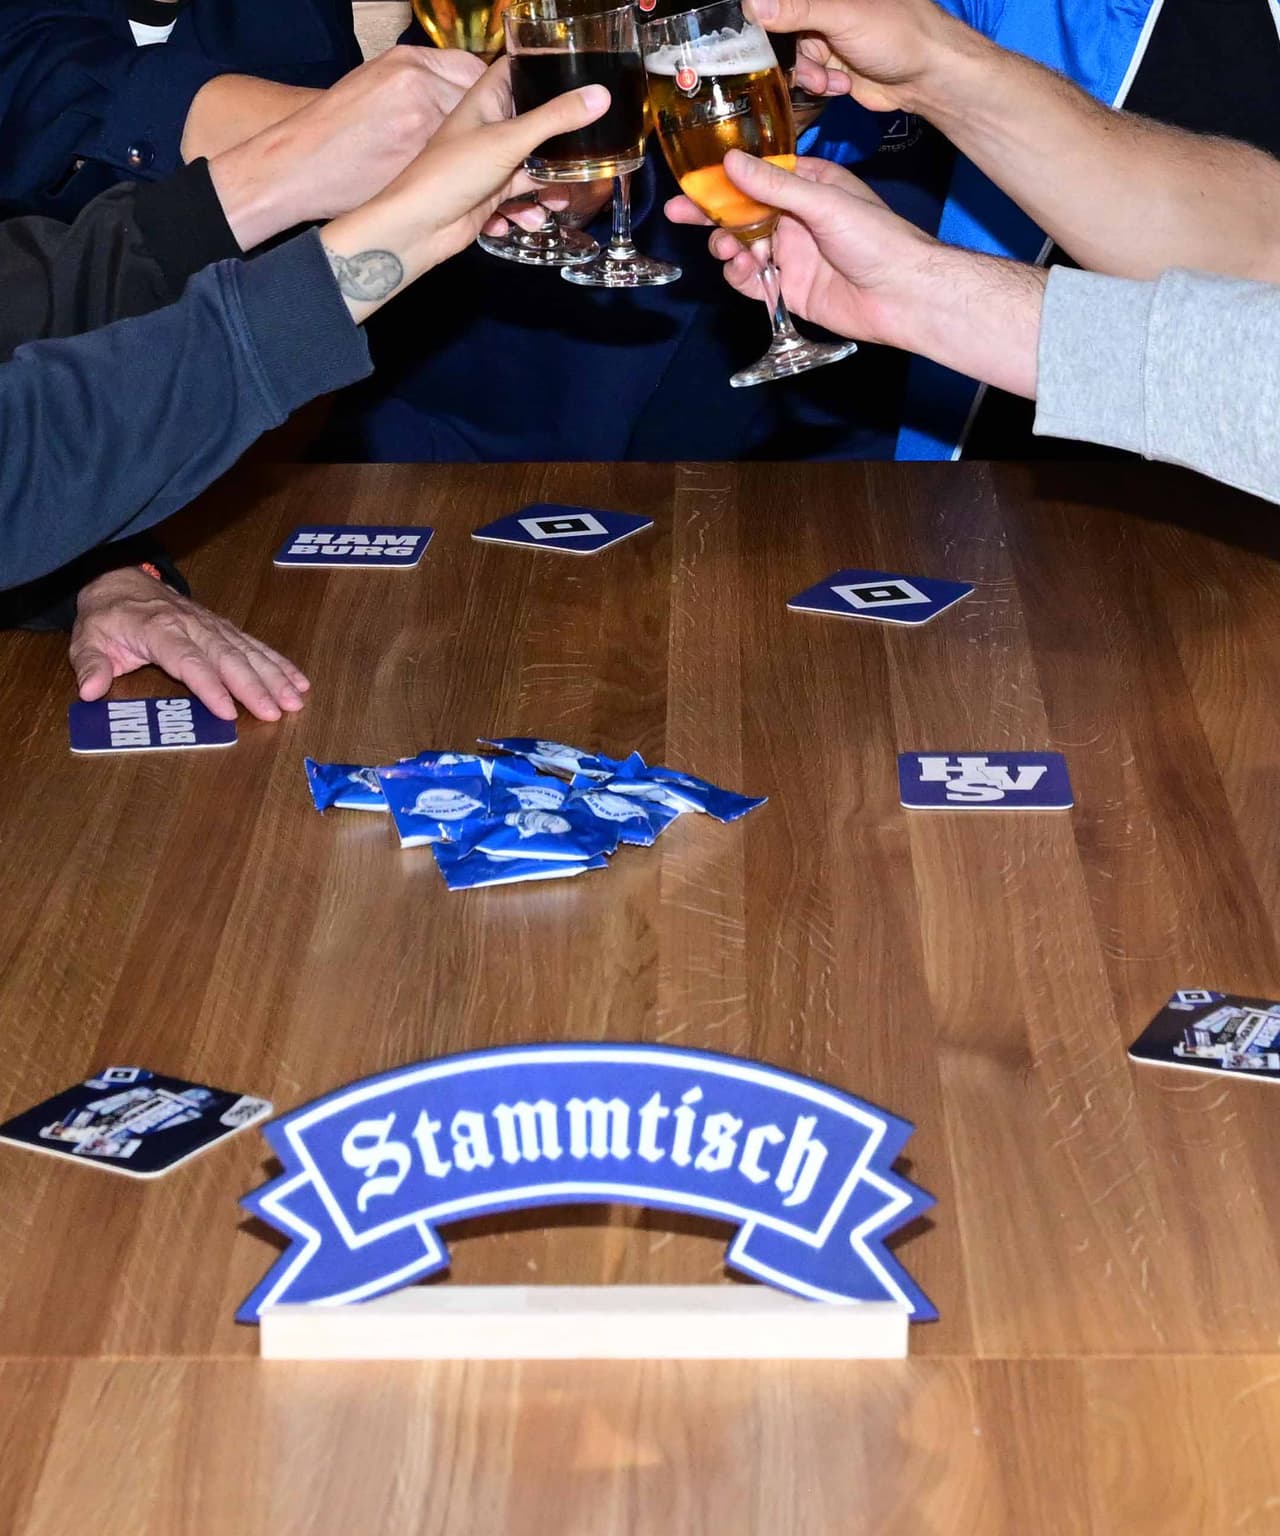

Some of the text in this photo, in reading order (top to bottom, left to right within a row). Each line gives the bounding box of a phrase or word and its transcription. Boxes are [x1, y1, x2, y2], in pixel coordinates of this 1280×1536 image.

[287, 545, 415, 557] BURG
[294, 533, 421, 546] HAM
[107, 700, 151, 747] HAM
[155, 698, 196, 745] BURG
[341, 1084, 829, 1214] Stammtisch
